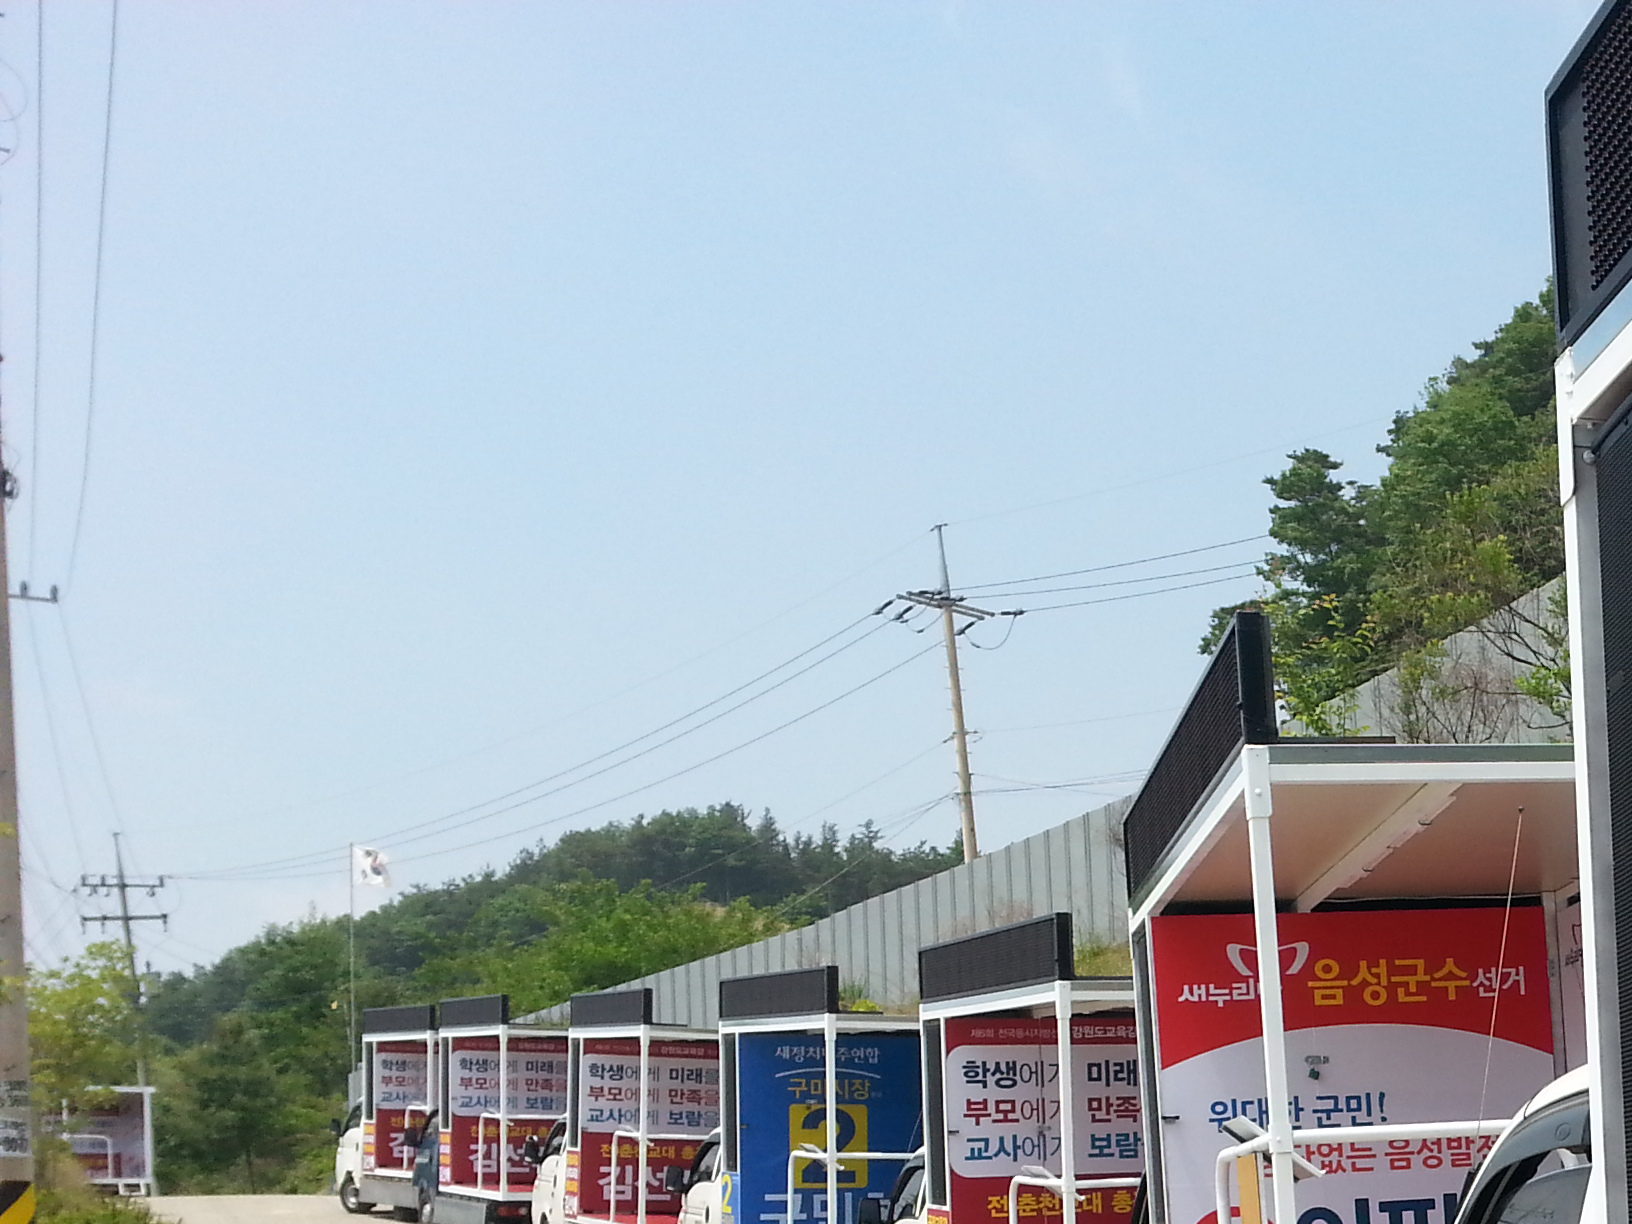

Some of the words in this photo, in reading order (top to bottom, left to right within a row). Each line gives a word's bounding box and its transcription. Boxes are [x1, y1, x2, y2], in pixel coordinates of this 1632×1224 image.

[1177, 977, 1283, 1008] 새누리
[775, 1046, 881, 1064] 새정치주연합
[1312, 1091, 1386, 1129] 군민!
